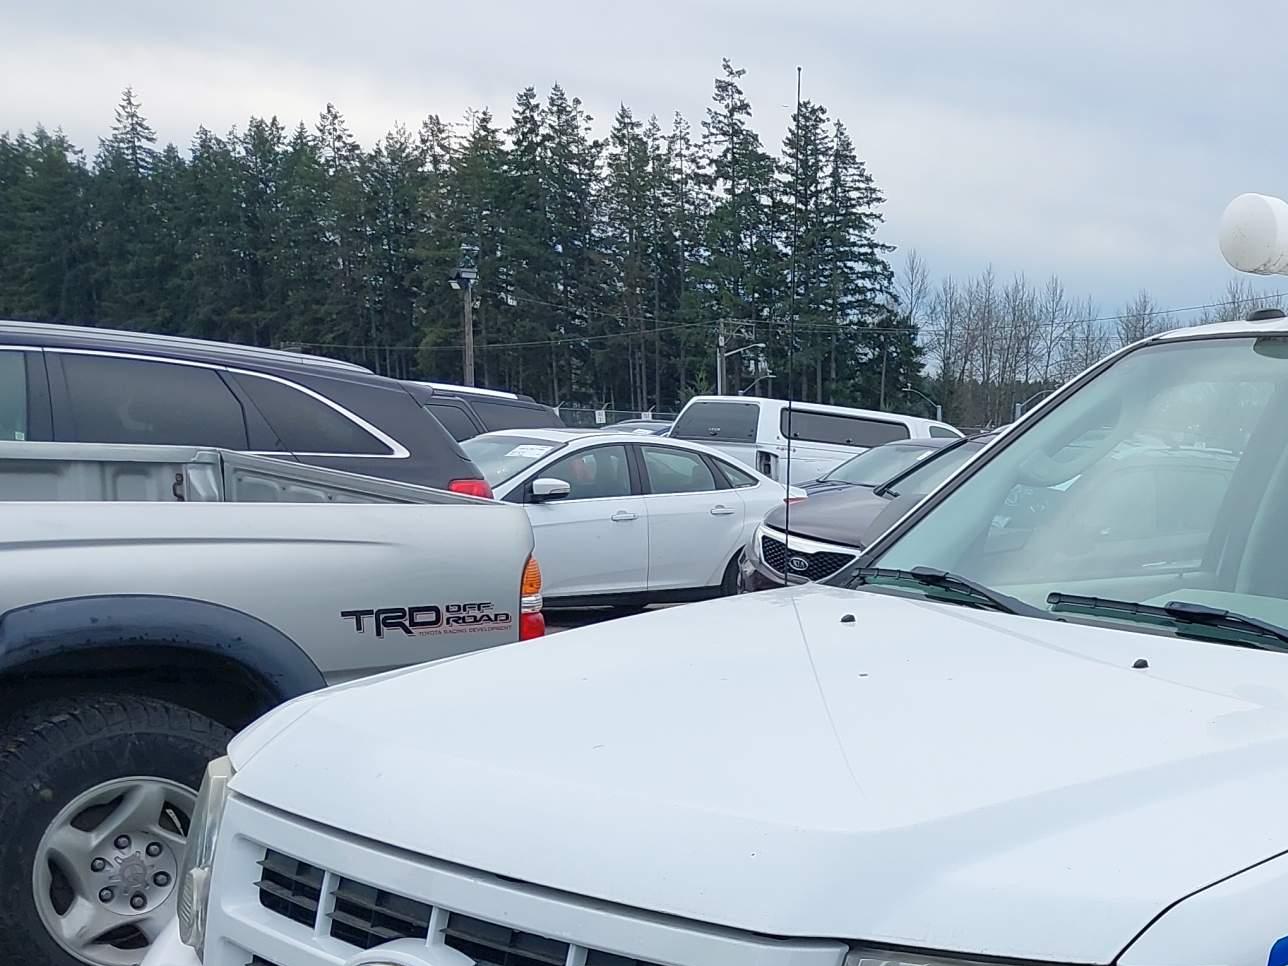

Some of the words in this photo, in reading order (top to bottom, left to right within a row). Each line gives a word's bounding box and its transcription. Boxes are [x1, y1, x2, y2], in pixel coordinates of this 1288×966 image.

[446, 602, 495, 614] OFF
[340, 605, 442, 639] TRD
[446, 612, 512, 627] ROAD
[419, 629, 442, 637] TOYOTA
